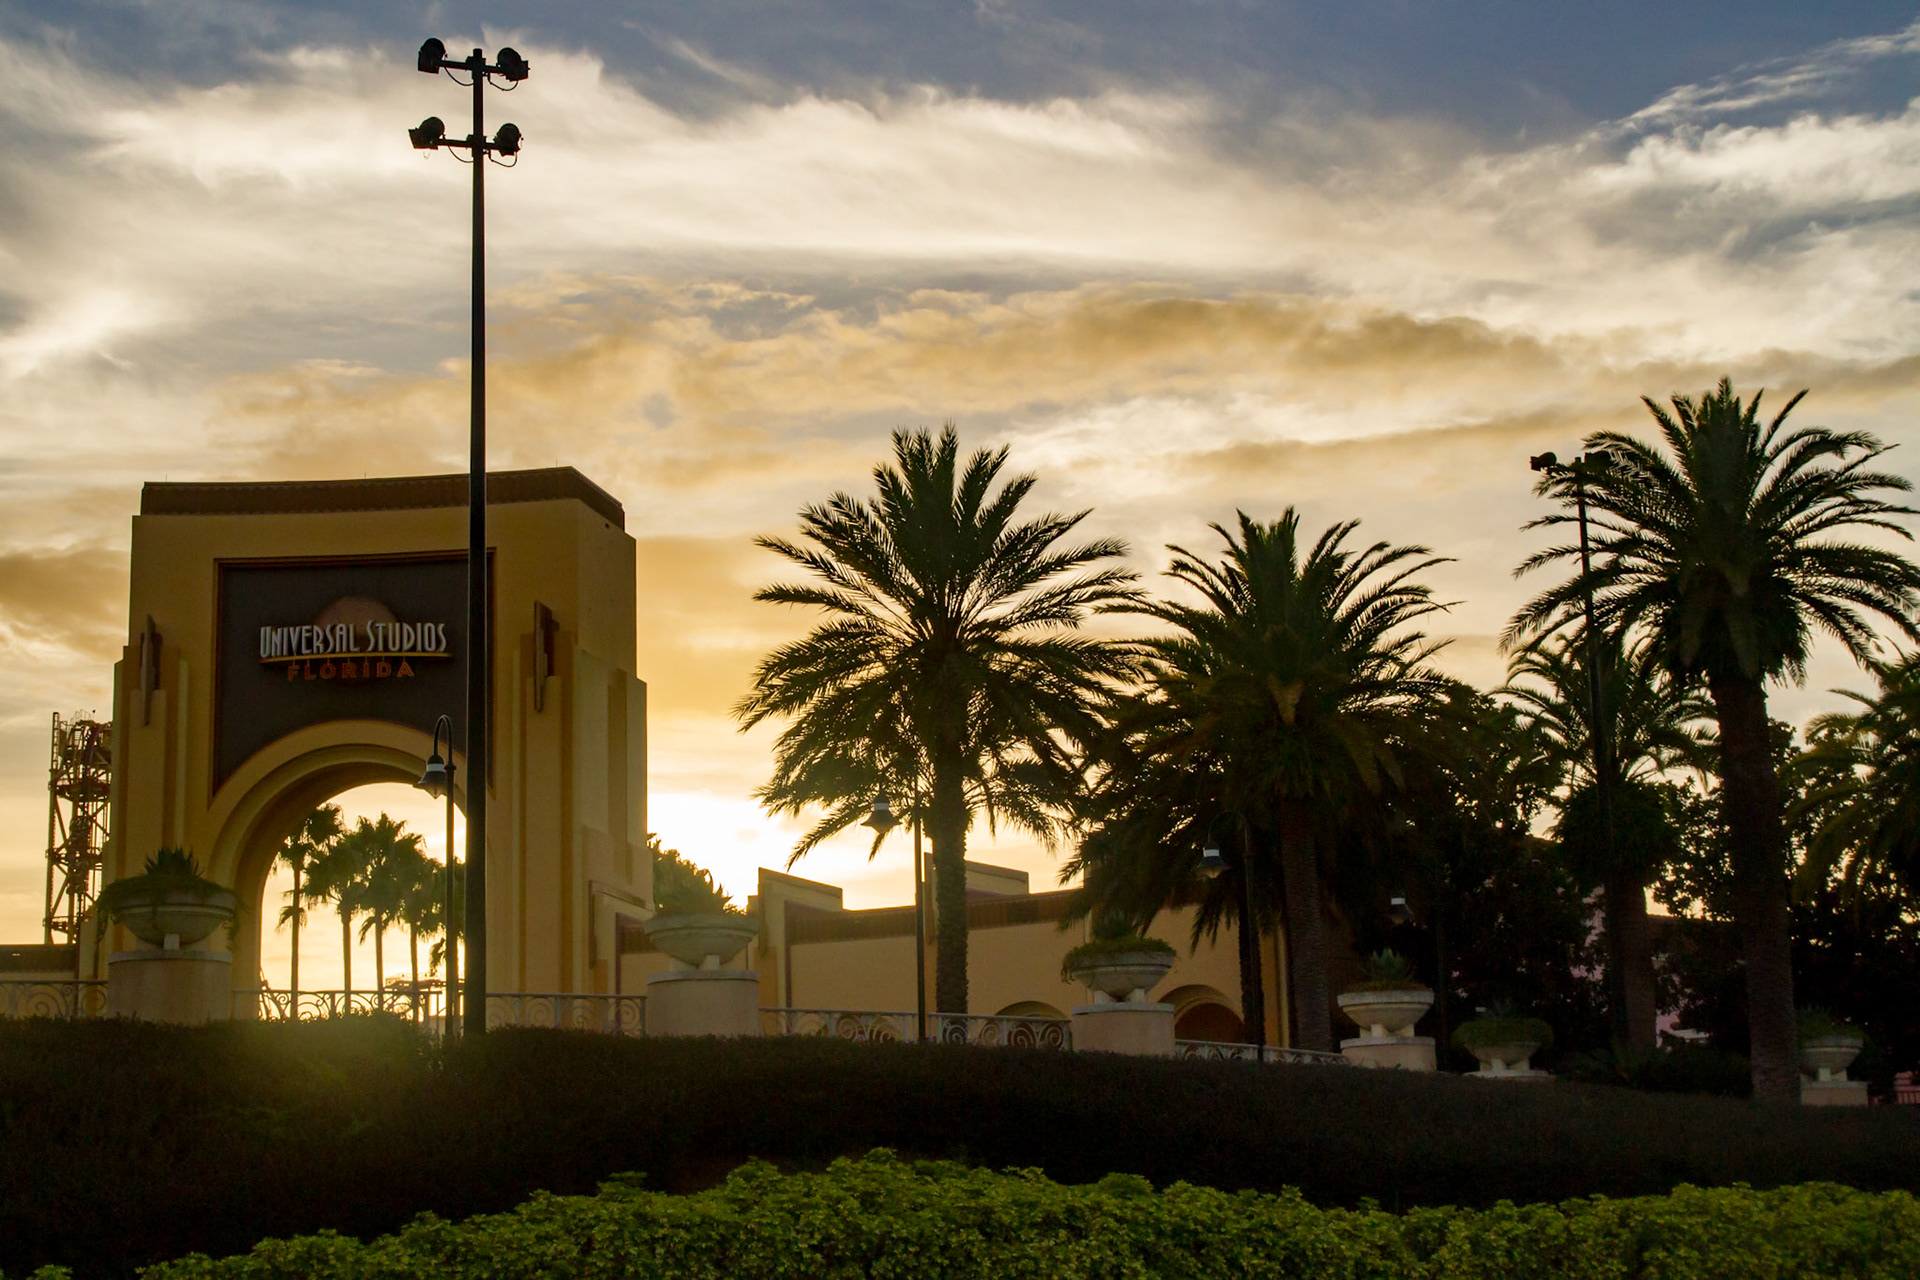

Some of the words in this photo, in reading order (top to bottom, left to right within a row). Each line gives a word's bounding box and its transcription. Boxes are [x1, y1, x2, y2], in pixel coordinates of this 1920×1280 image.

[260, 623, 360, 658] UNIVERSAL
[366, 620, 447, 652] STUDIOS
[288, 661, 415, 681] FLORIDA
